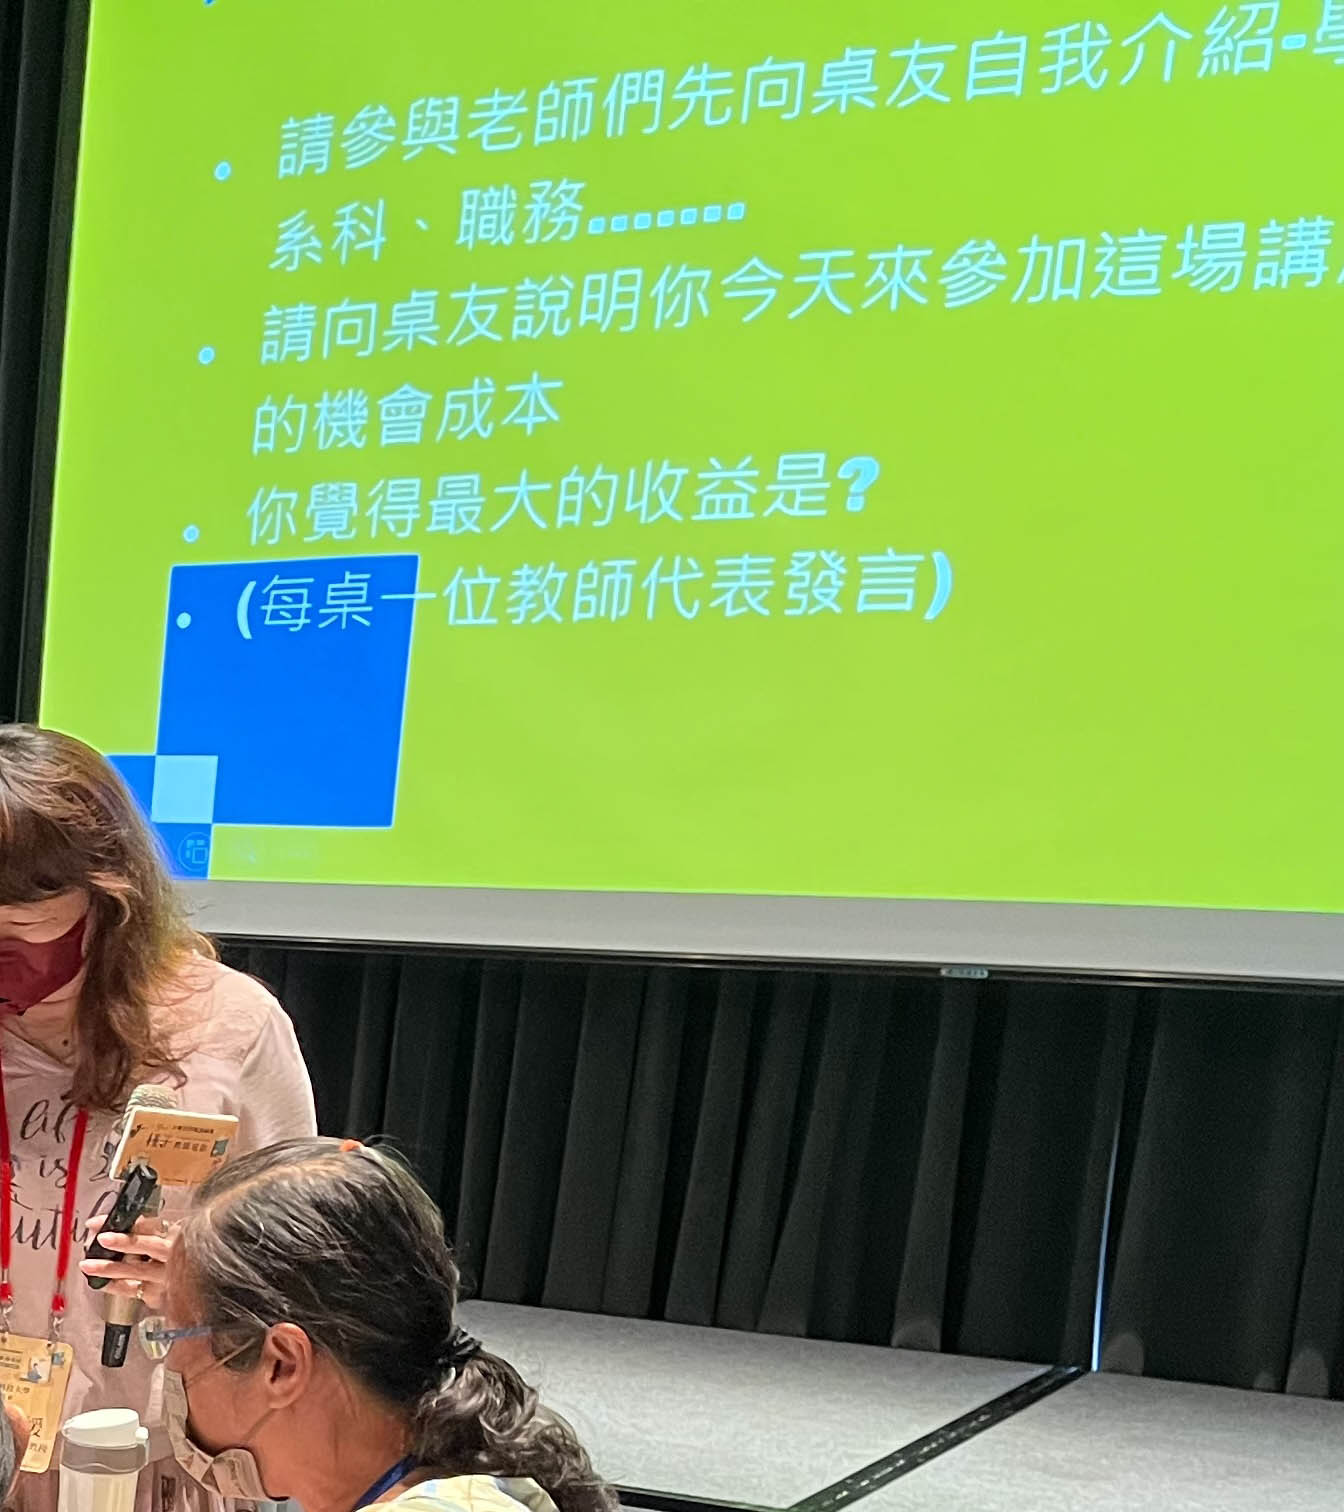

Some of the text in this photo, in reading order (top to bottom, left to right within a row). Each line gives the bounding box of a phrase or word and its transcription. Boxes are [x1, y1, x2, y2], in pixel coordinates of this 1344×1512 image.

[260, 216, 1344, 365] 請向桌友說明你今天來參加這場講
[252, 372, 564, 455] 的機會成本
[246, 452, 880, 546] 你覺得最大的收益是?
[237, 548, 954, 638] (每桌一位教師代表發言)
